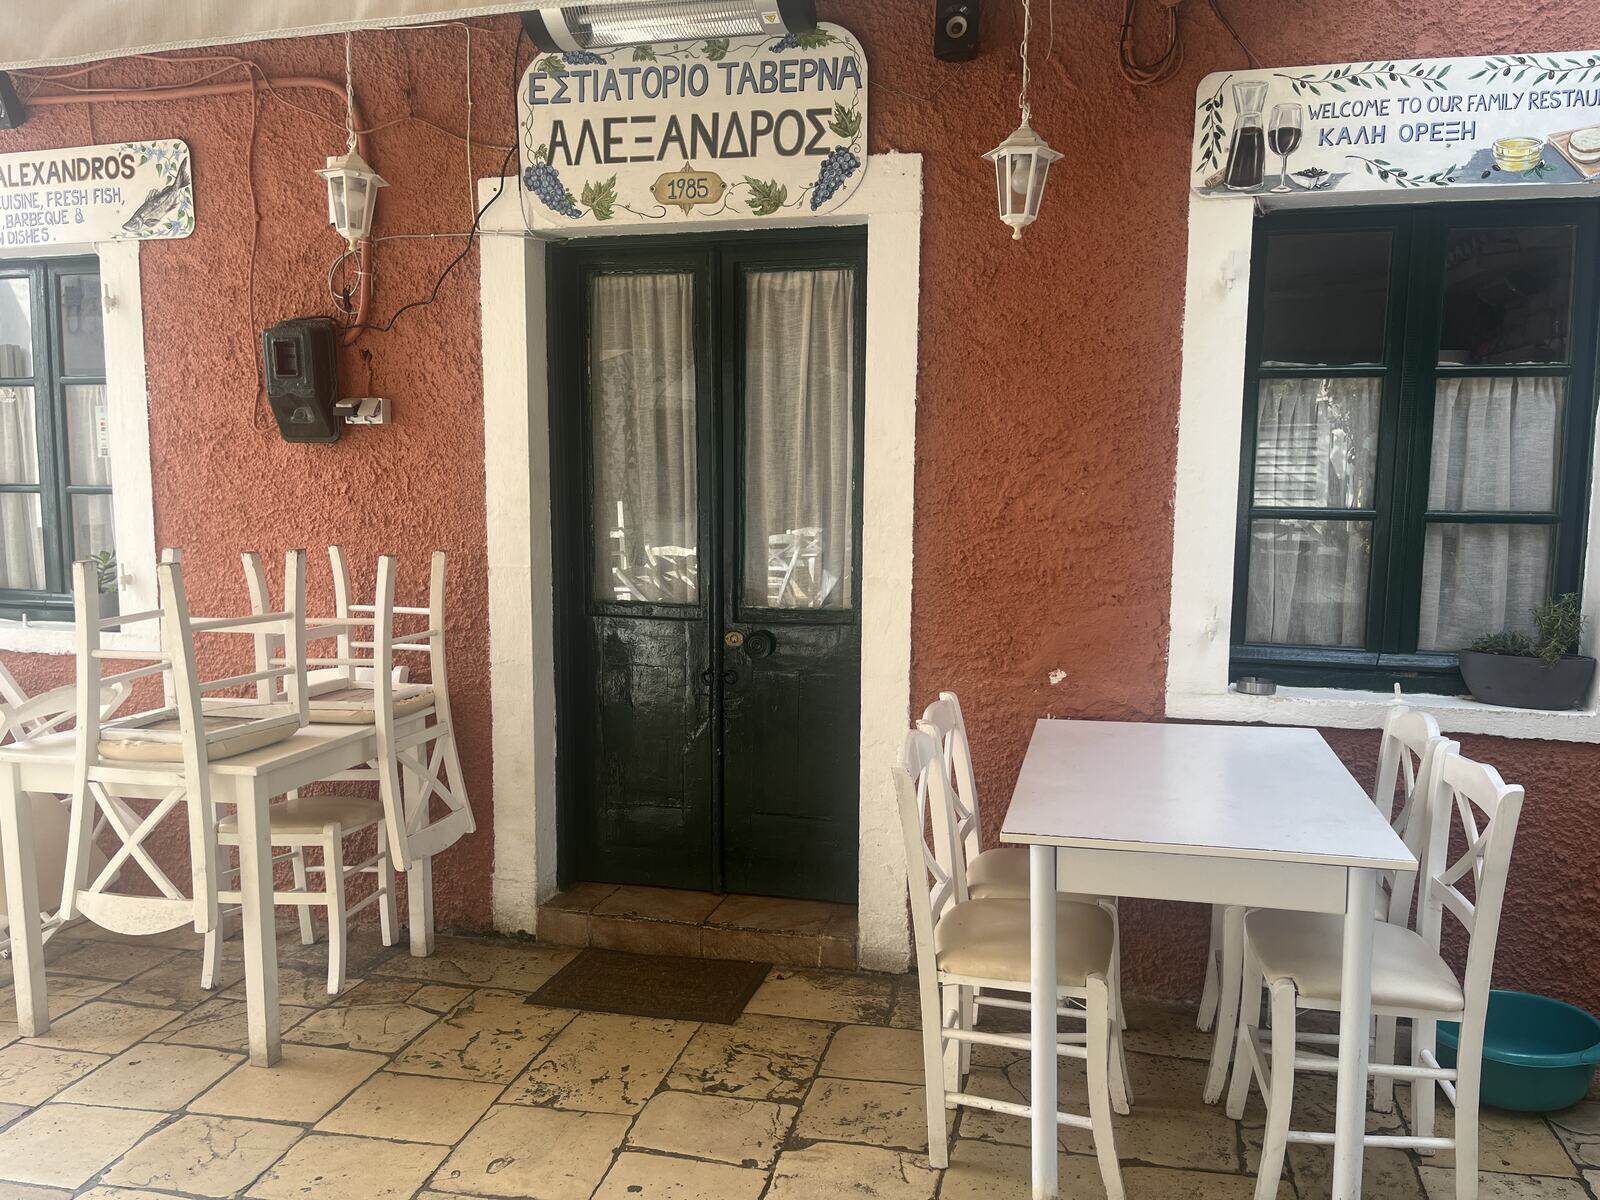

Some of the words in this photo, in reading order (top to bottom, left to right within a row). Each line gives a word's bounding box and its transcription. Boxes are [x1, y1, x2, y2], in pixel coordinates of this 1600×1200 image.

[528, 63, 709, 105] ΕΣΤΙΑΤΟΡΙΟ
[717, 56, 862, 95] ΤΑΒΕΡΝΑ
[1307, 99, 1391, 121] WELCOME
[1397, 97, 1422, 115] TO
[1426, 95, 1463, 113] OUR
[1466, 91, 1525, 113] FAMILY
[549, 107, 833, 166] ΑΛΕΞΑΝΔΡΟΣ
[1317, 124, 1387, 147] ΚΑΛΗ
[1399, 121, 1477, 143] ΟΡΕΞΗ
[0, 191, 44, 210] UISINE,
[46, 189, 88, 208] FRESH
[93, 187, 126, 206] FISH,
[667, 178, 709, 200] 1985
[75, 207, 85, 224] &
